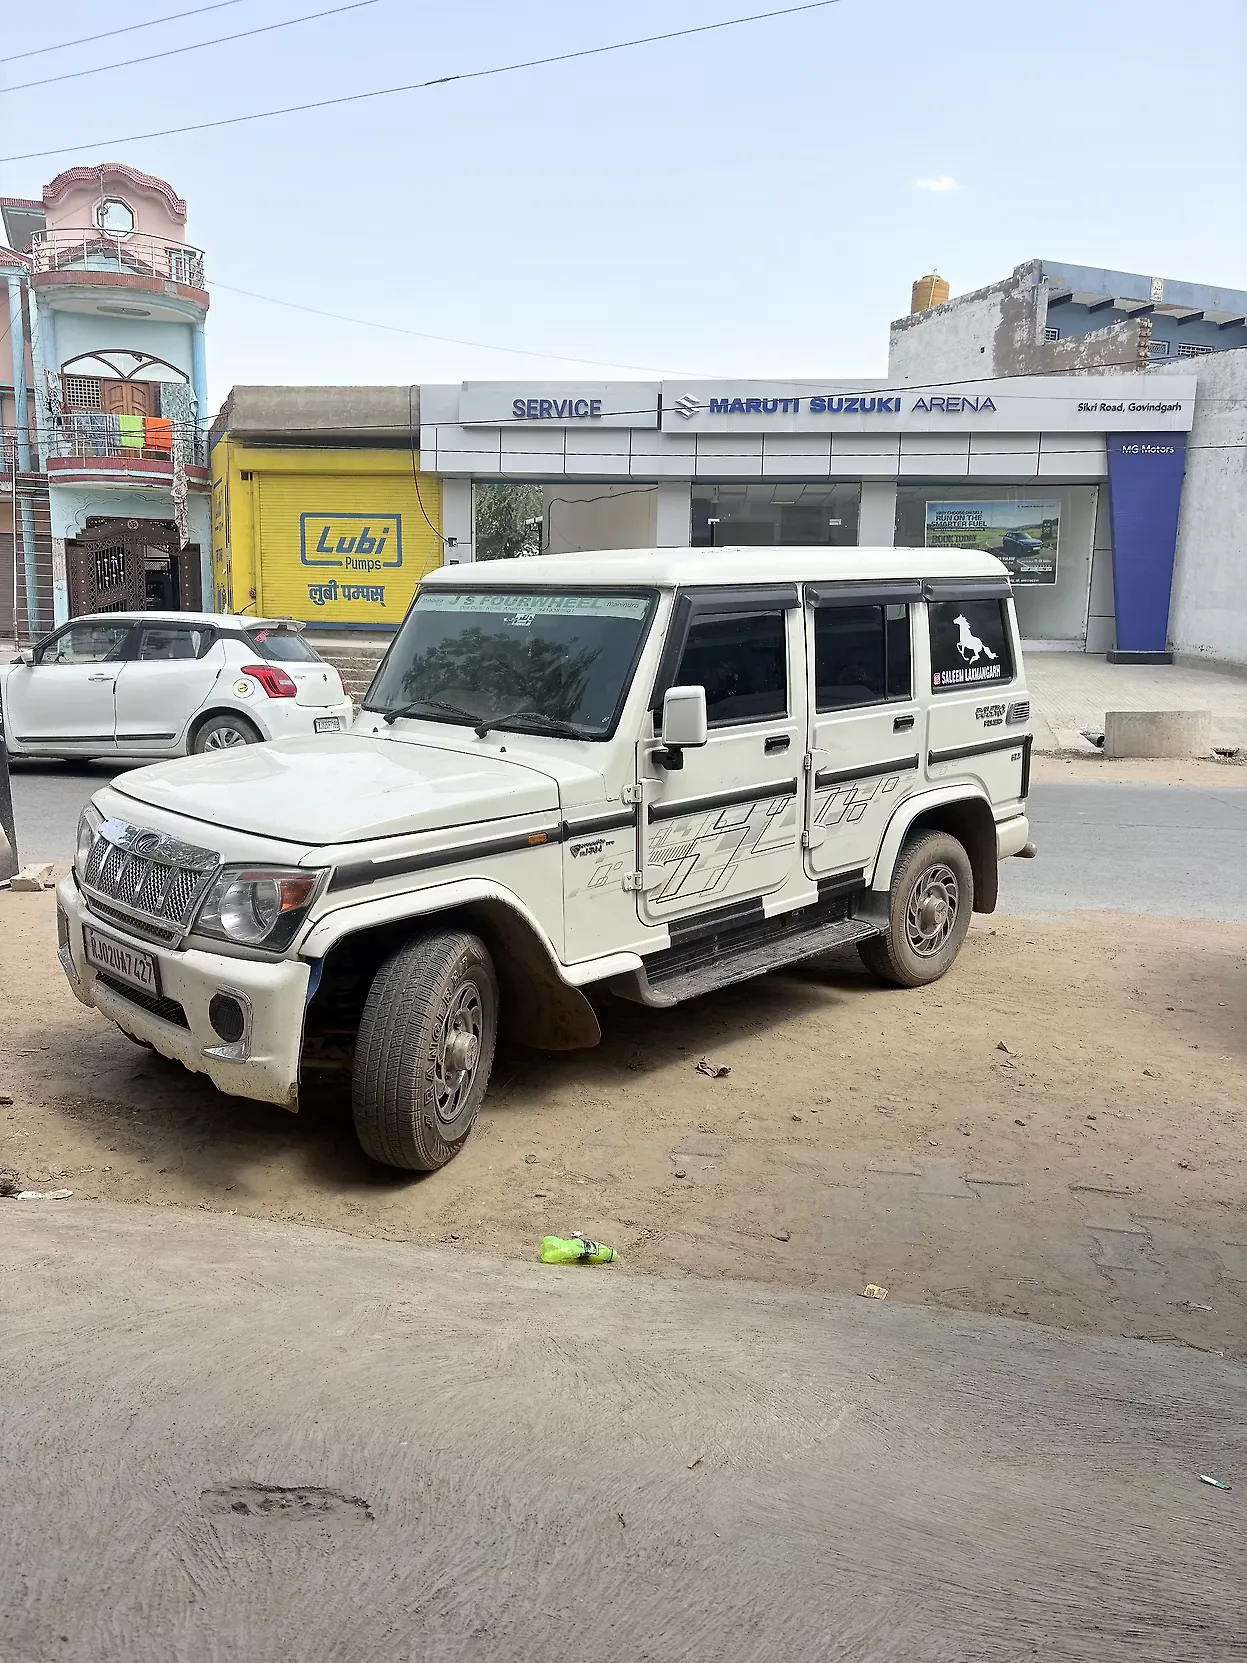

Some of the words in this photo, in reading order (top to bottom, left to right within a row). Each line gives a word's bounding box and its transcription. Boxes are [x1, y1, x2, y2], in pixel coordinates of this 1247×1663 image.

[512, 399, 602, 418] SERVICE
[709, 398, 800, 413] MARUTI
[809, 397, 901, 413] SUZUKI
[911, 397, 997, 412] ARENA
[1077, 402, 1098, 412] Sikri
[1099, 402, 1126, 413] Road,
[1128, 402, 1182, 414] Govindgarh
[1122, 445, 1139, 454] MG
[1141, 444, 1175, 454] Motors
[316, 526, 390, 554] Lubi
[345, 556, 382, 572] Pumps
[307, 579, 340, 606] लुबी
[480, 595, 602, 609] FOURWHEEL
[942, 669, 964, 684] SALEEM
